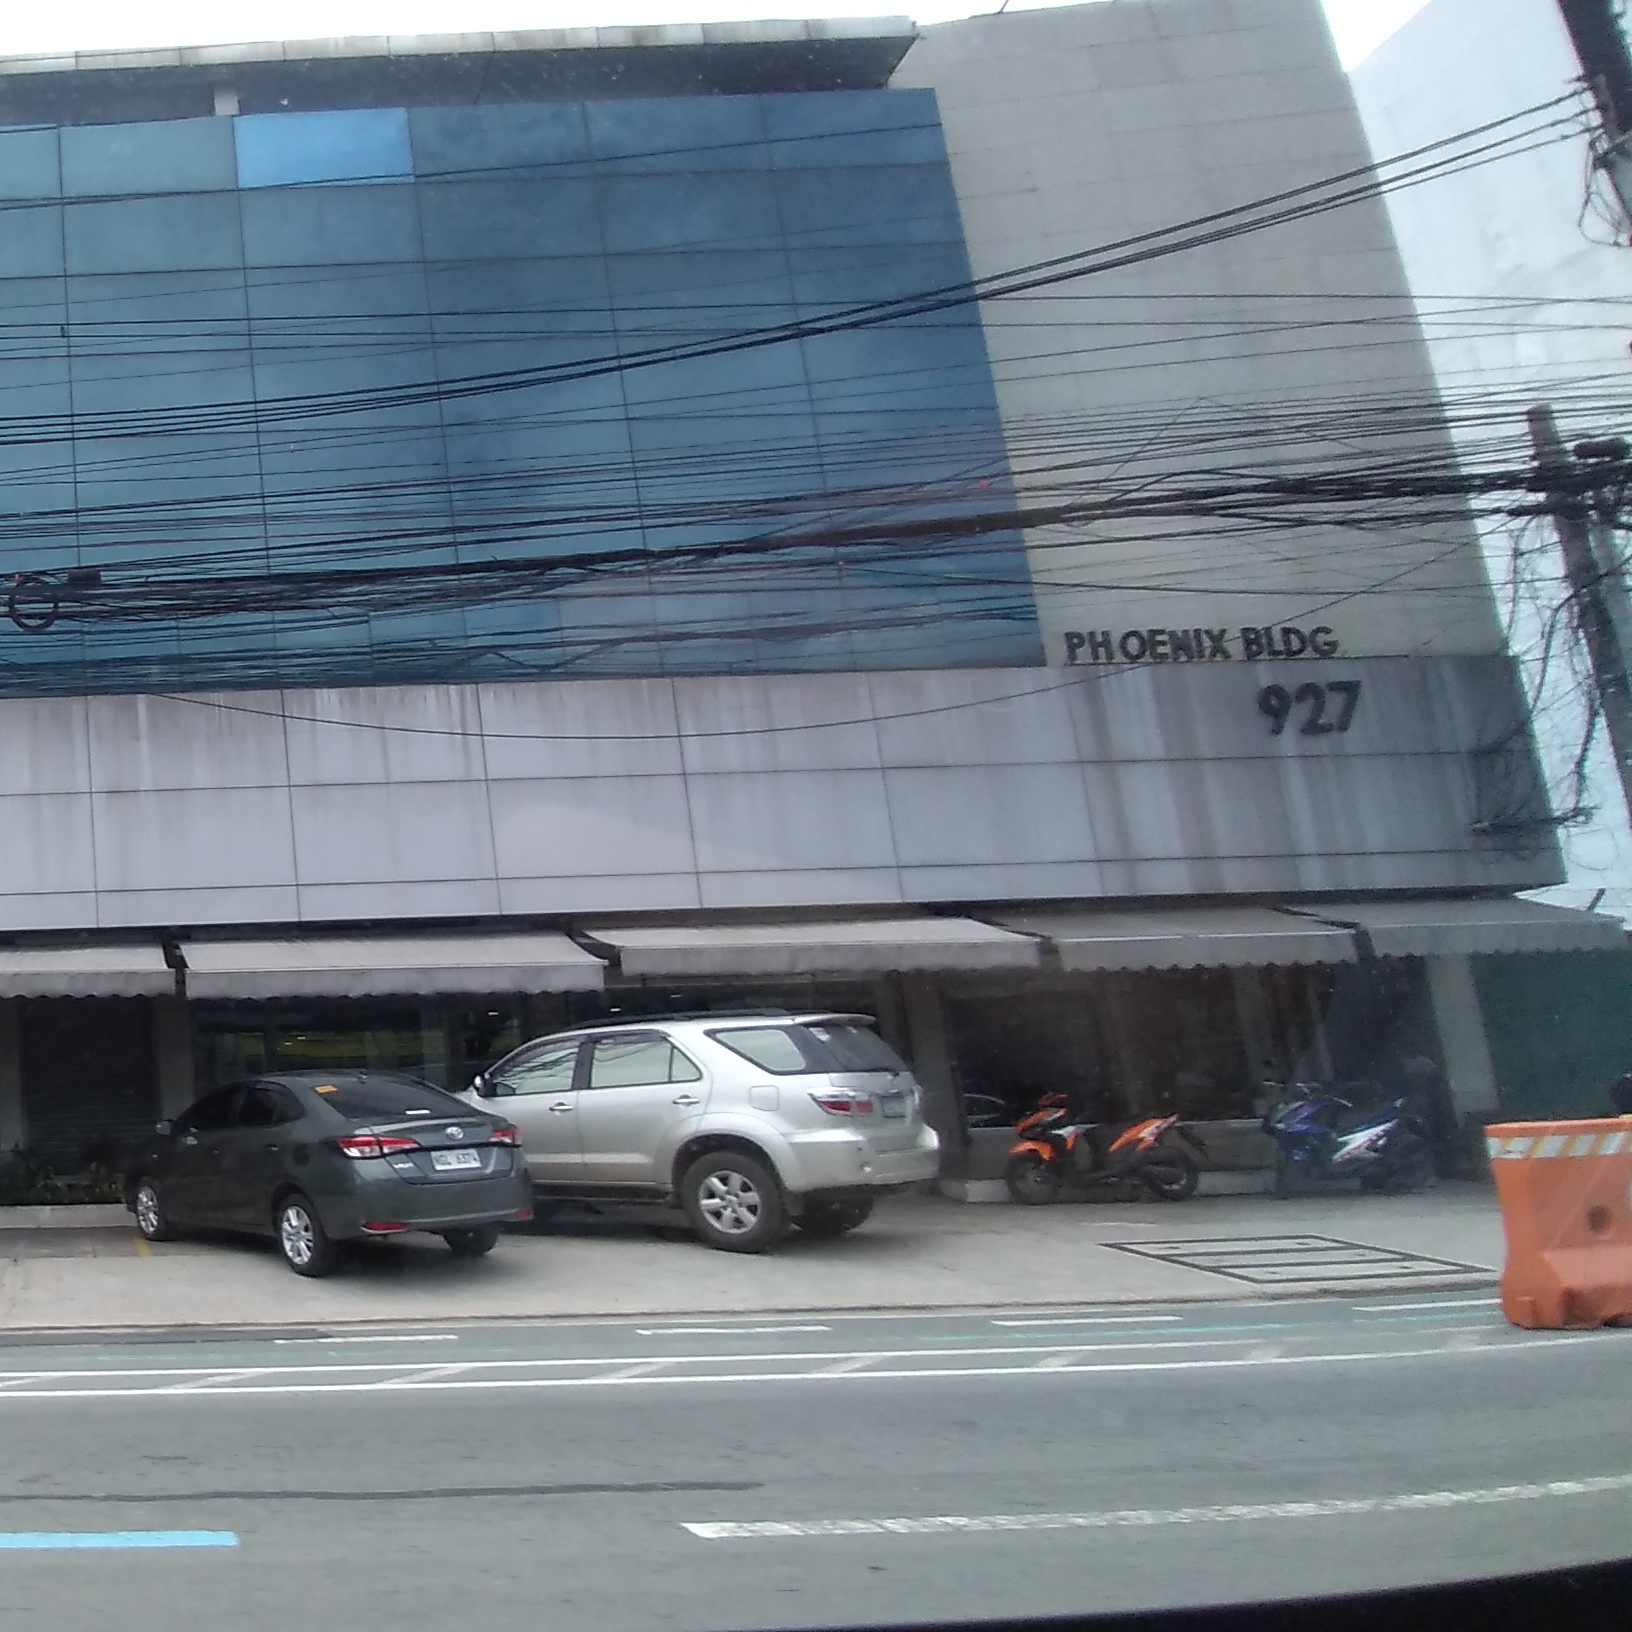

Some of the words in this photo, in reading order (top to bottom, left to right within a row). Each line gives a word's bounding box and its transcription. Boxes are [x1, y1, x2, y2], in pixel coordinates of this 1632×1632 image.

[1064, 628, 1231, 662] PHOENIX
[1240, 626, 1339, 659] BLDG
[1258, 680, 1362, 735] 927
